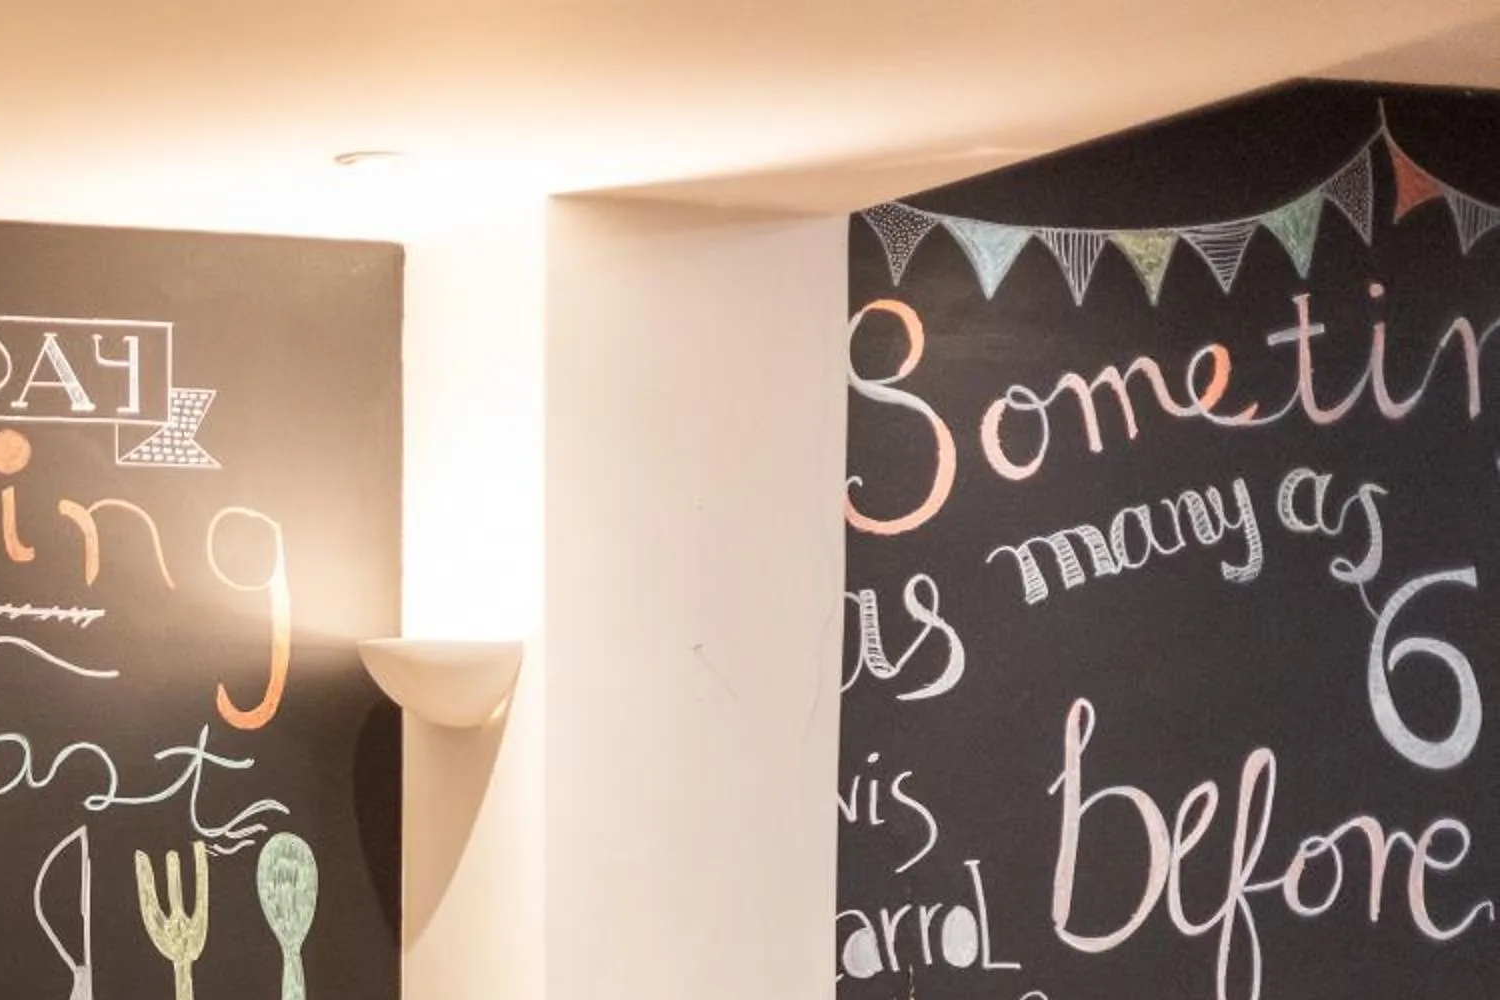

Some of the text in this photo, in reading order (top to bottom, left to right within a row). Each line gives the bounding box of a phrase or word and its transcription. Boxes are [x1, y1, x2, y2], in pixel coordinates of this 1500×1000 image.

[986, 477, 1263, 604] many
[1277, 467, 1388, 583] as
[1367, 565, 1483, 769] 6
